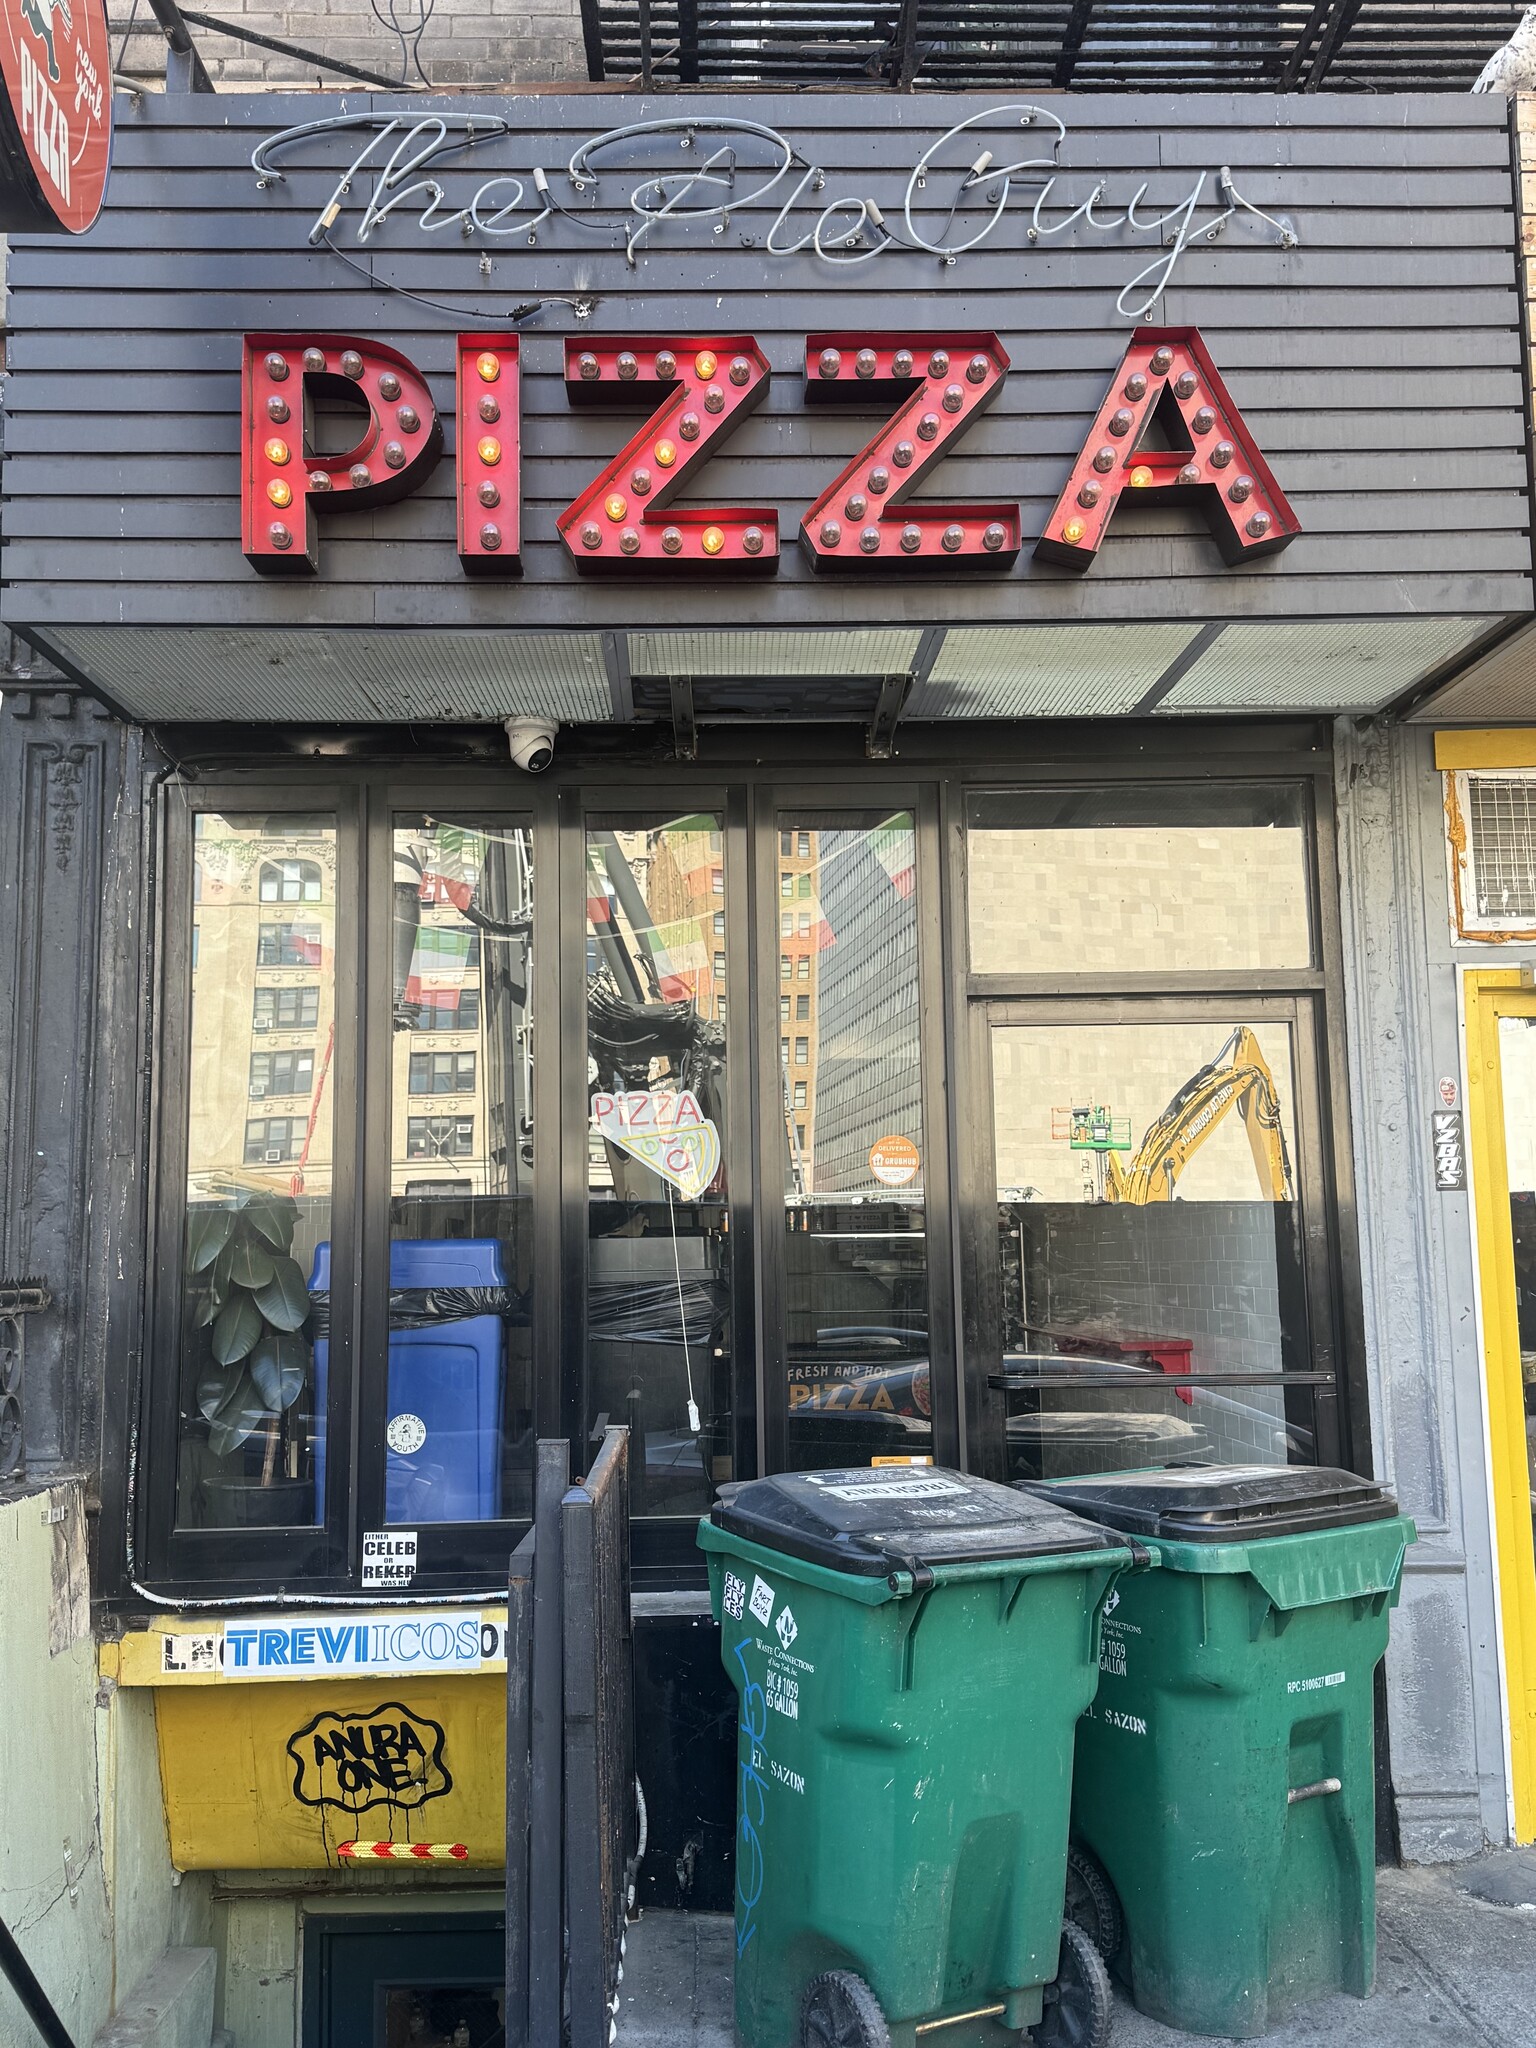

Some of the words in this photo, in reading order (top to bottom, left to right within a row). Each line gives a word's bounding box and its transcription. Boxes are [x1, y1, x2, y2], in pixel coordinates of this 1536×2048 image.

[76, 36, 97, 87] new
[20, 37, 70, 208] PIZZA
[251, 111, 553, 246] The
[241, 326, 1302, 577] PIZZA
[595, 1094, 701, 1127] PIZZA
[787, 1365, 828, 1382] FRESH
[834, 1366, 860, 1378] AND
[865, 1365, 891, 1378] HOT
[788, 1383, 895, 1411] PIZZA
[389, 1415, 425, 1434] AFFIRMATIVE
[391, 1440, 419, 1452] YOUTH
[841, 1487, 890, 1496] ONLY
[889, 1482, 955, 1494] TRASH
[364, 1541, 416, 1556] CELEB
[755, 1585, 772, 1605] FART
[1107, 1639, 1126, 1659] 1059
[1099, 1654, 1127, 1677] GALLON
[766, 1669, 777, 1692] BIC
[782, 1676, 799, 1699] 1059
[1287, 1681, 1301, 1694] RPC
[1301, 1676, 1325, 1692] 5100627
[766, 1689, 774, 1708] 65
[773, 1692, 799, 1720] GALLON
[1104, 1708, 1147, 1736] SAZON
[337, 1756, 429, 1793] ONE
[770, 1760, 805, 1795] SAZON
